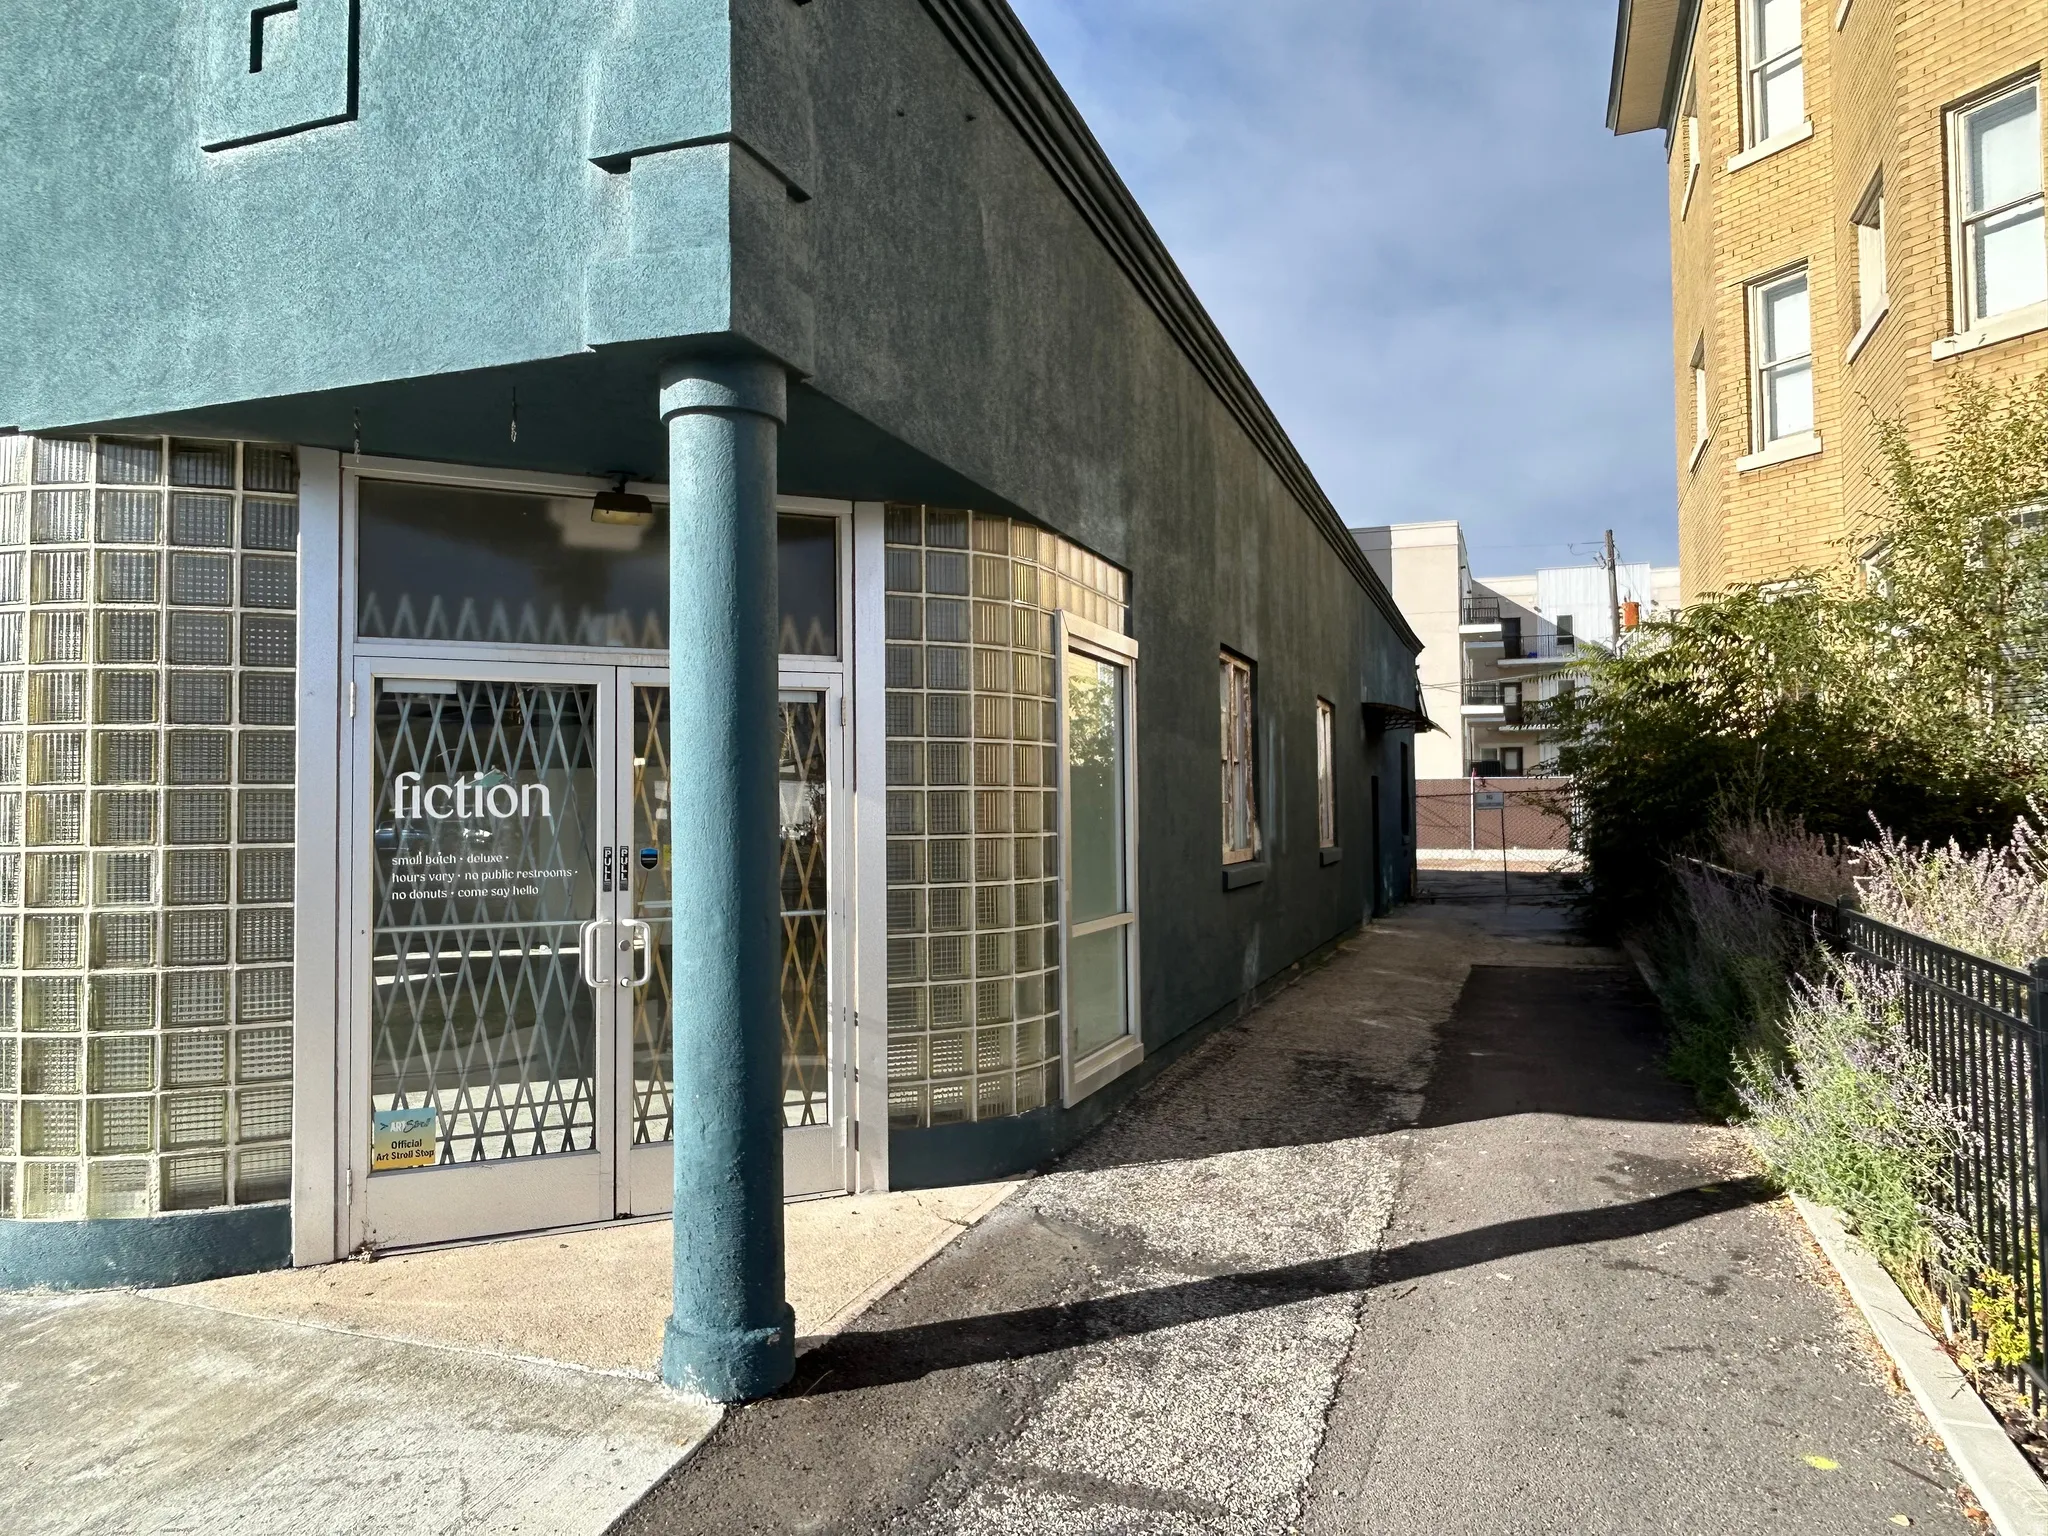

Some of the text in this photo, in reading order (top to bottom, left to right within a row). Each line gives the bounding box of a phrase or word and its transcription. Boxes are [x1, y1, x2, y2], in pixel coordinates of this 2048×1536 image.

[395, 771, 551, 818] fiction
[392, 853, 503, 865] small batch deluxe
[392, 869, 572, 883] hours vary no public restrooms
[392, 885, 539, 900] no donuts come say hello
[391, 1138, 422, 1149] Official
[376, 1149, 435, 1161] Art Stroll Stop
